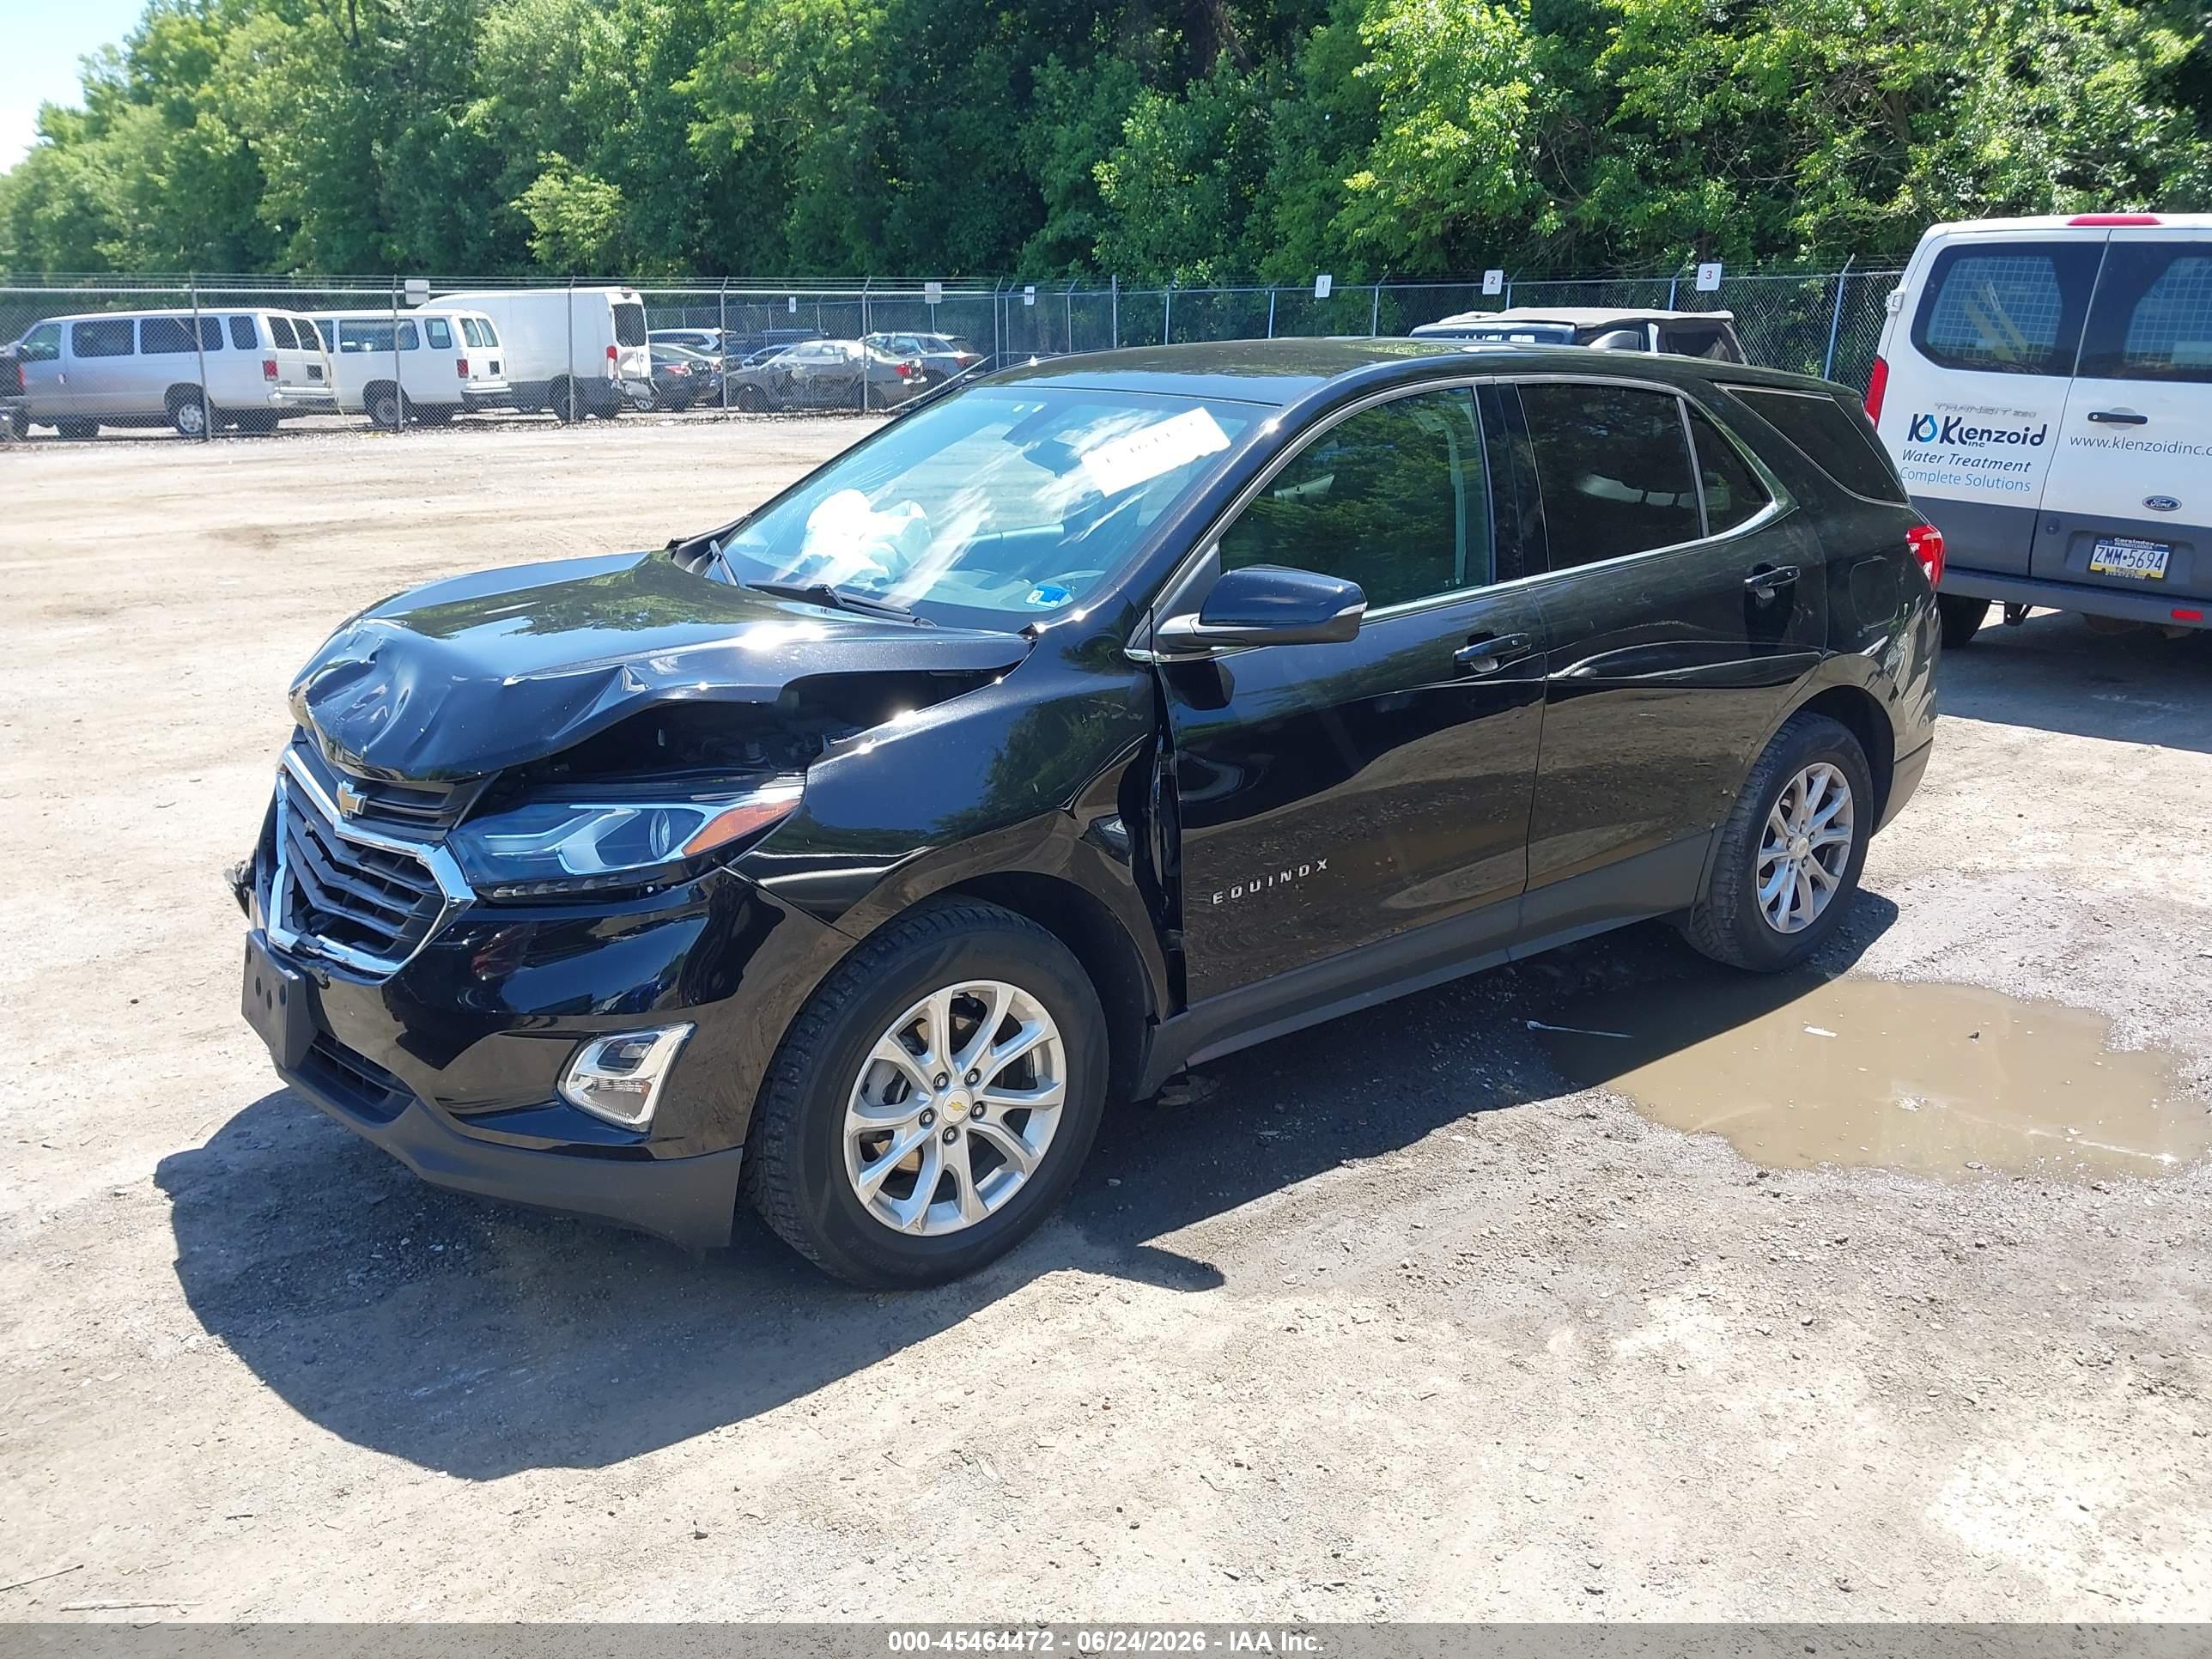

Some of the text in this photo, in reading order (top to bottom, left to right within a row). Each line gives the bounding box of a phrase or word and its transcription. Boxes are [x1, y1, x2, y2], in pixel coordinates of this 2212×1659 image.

[1489, 276, 1497, 285] 2
[1705, 270, 1713, 280] 3
[1939, 416, 2048, 447] Klenzoid
[1901, 448, 2032, 473] Water Treatment
[1899, 466, 2032, 492] Complete Solutions
[1212, 858, 1328, 904] EQUINOX
